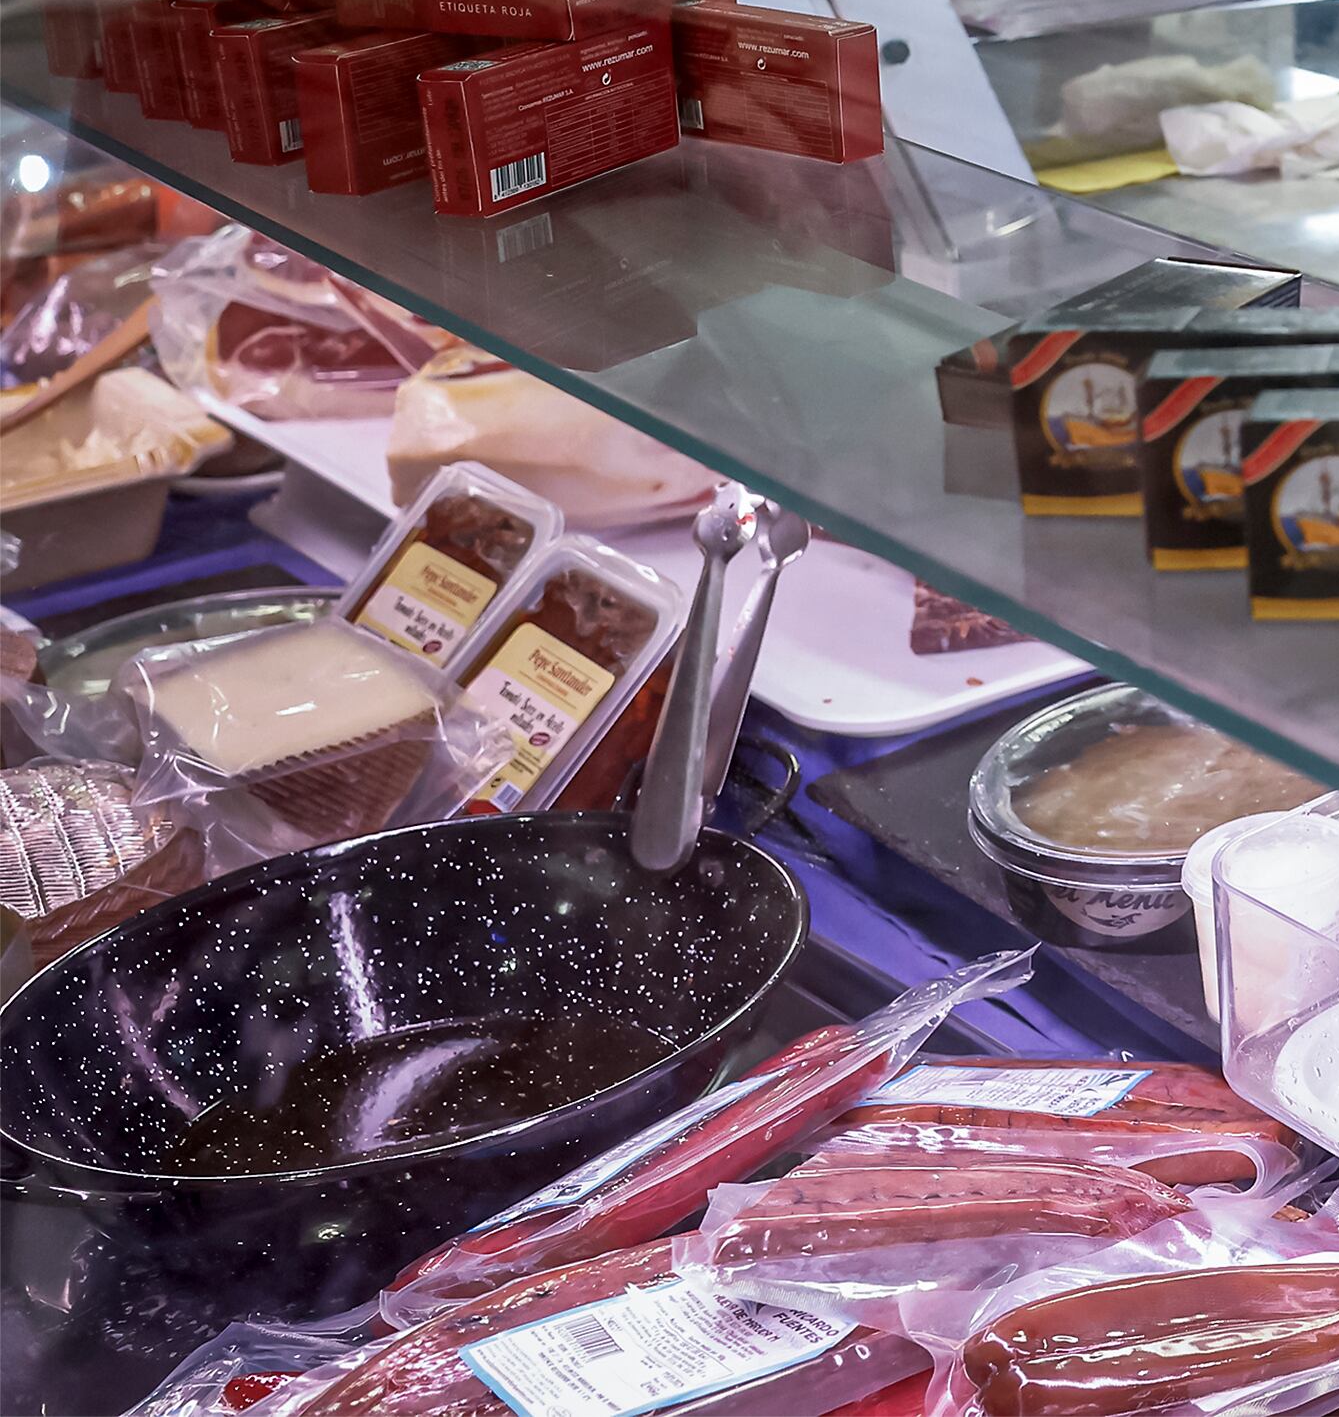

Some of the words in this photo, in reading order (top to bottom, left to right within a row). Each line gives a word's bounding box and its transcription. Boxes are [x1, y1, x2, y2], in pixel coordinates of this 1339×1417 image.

[438, 0, 497, 16] ETIQUETA
[501, 5, 533, 18] ROJA
[581, 43, 654, 73] www.rezumar.com
[737, 40, 810, 61] www.rezumar.com
[528, 648, 549, 671] Pepe
[548, 660, 593, 697] Santander
[732, 1307, 747, 1323] DE
[772, 1312, 823, 1345] FUENTES
[789, 1309, 840, 1338] RICARDO
